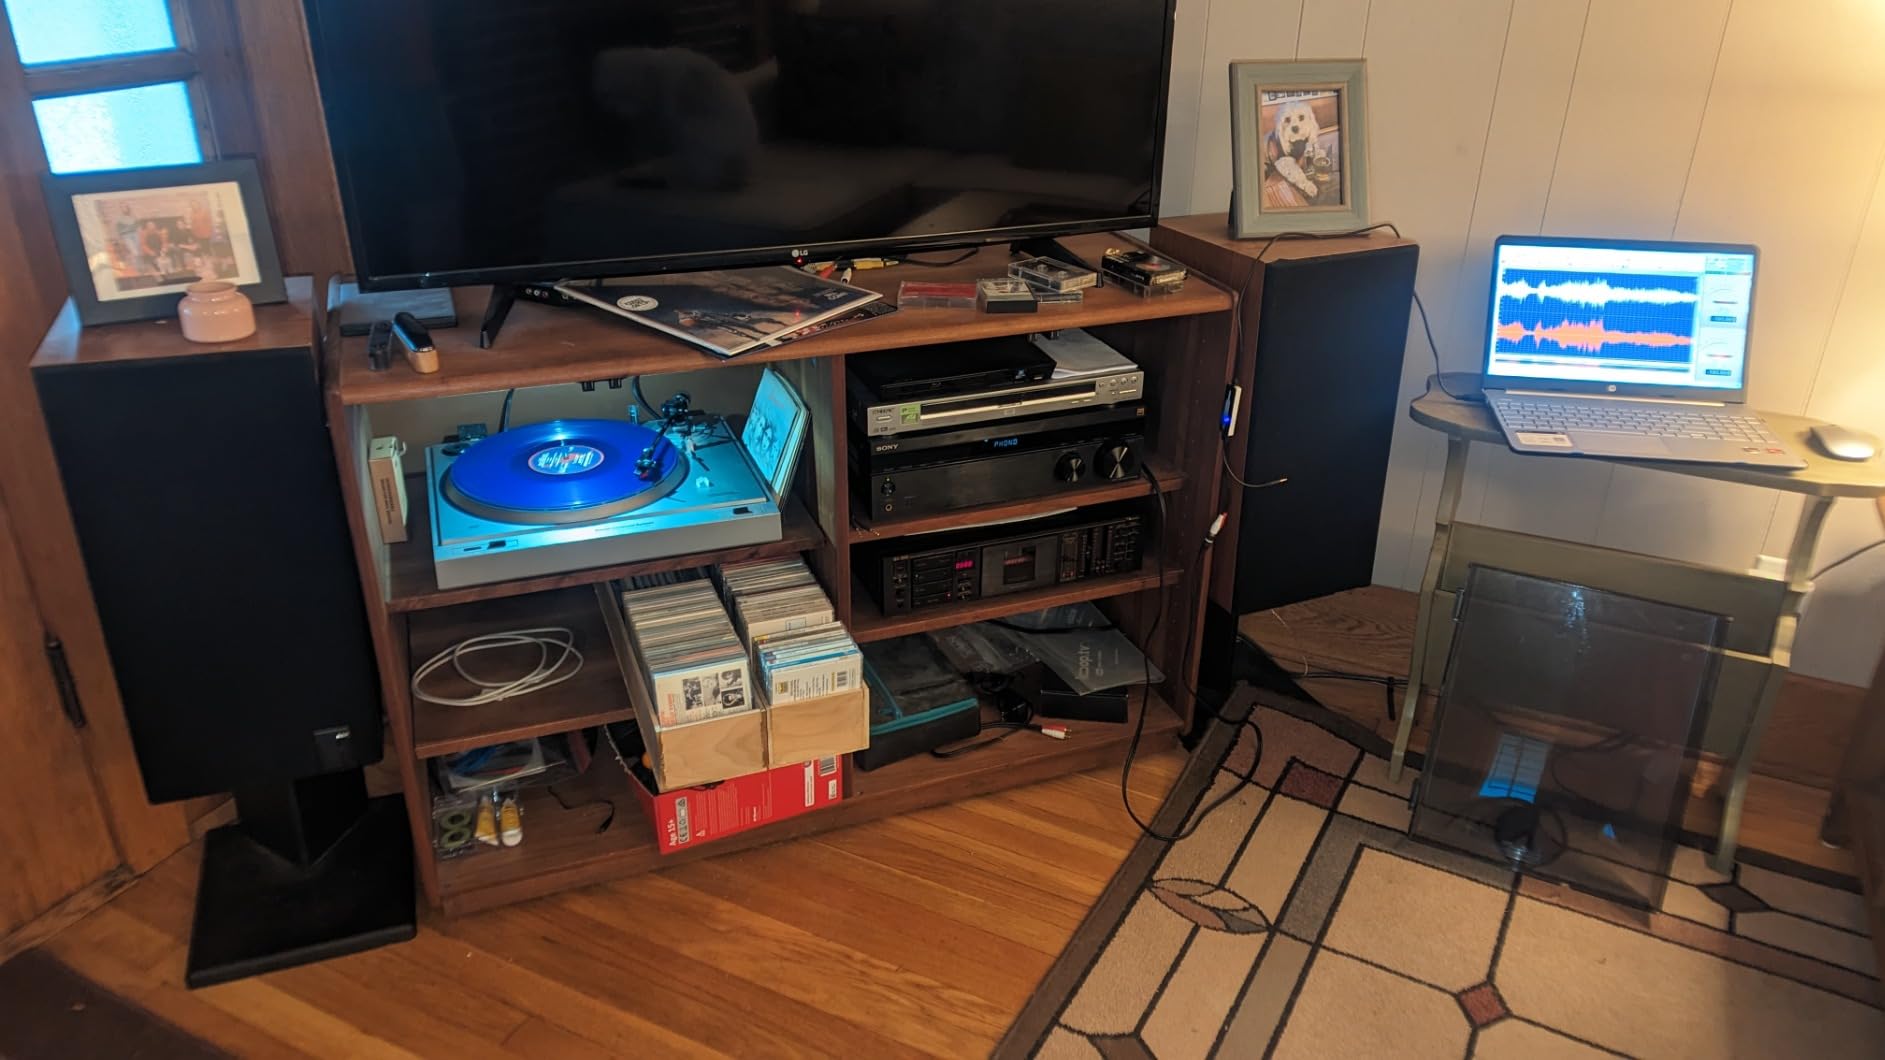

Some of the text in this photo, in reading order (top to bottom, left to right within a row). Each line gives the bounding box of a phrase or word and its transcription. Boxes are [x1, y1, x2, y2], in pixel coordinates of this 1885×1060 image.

[876, 443, 899, 452] SONY
[993, 438, 1018, 448] PHONO
[667, 819, 677, 846] Age 15+
